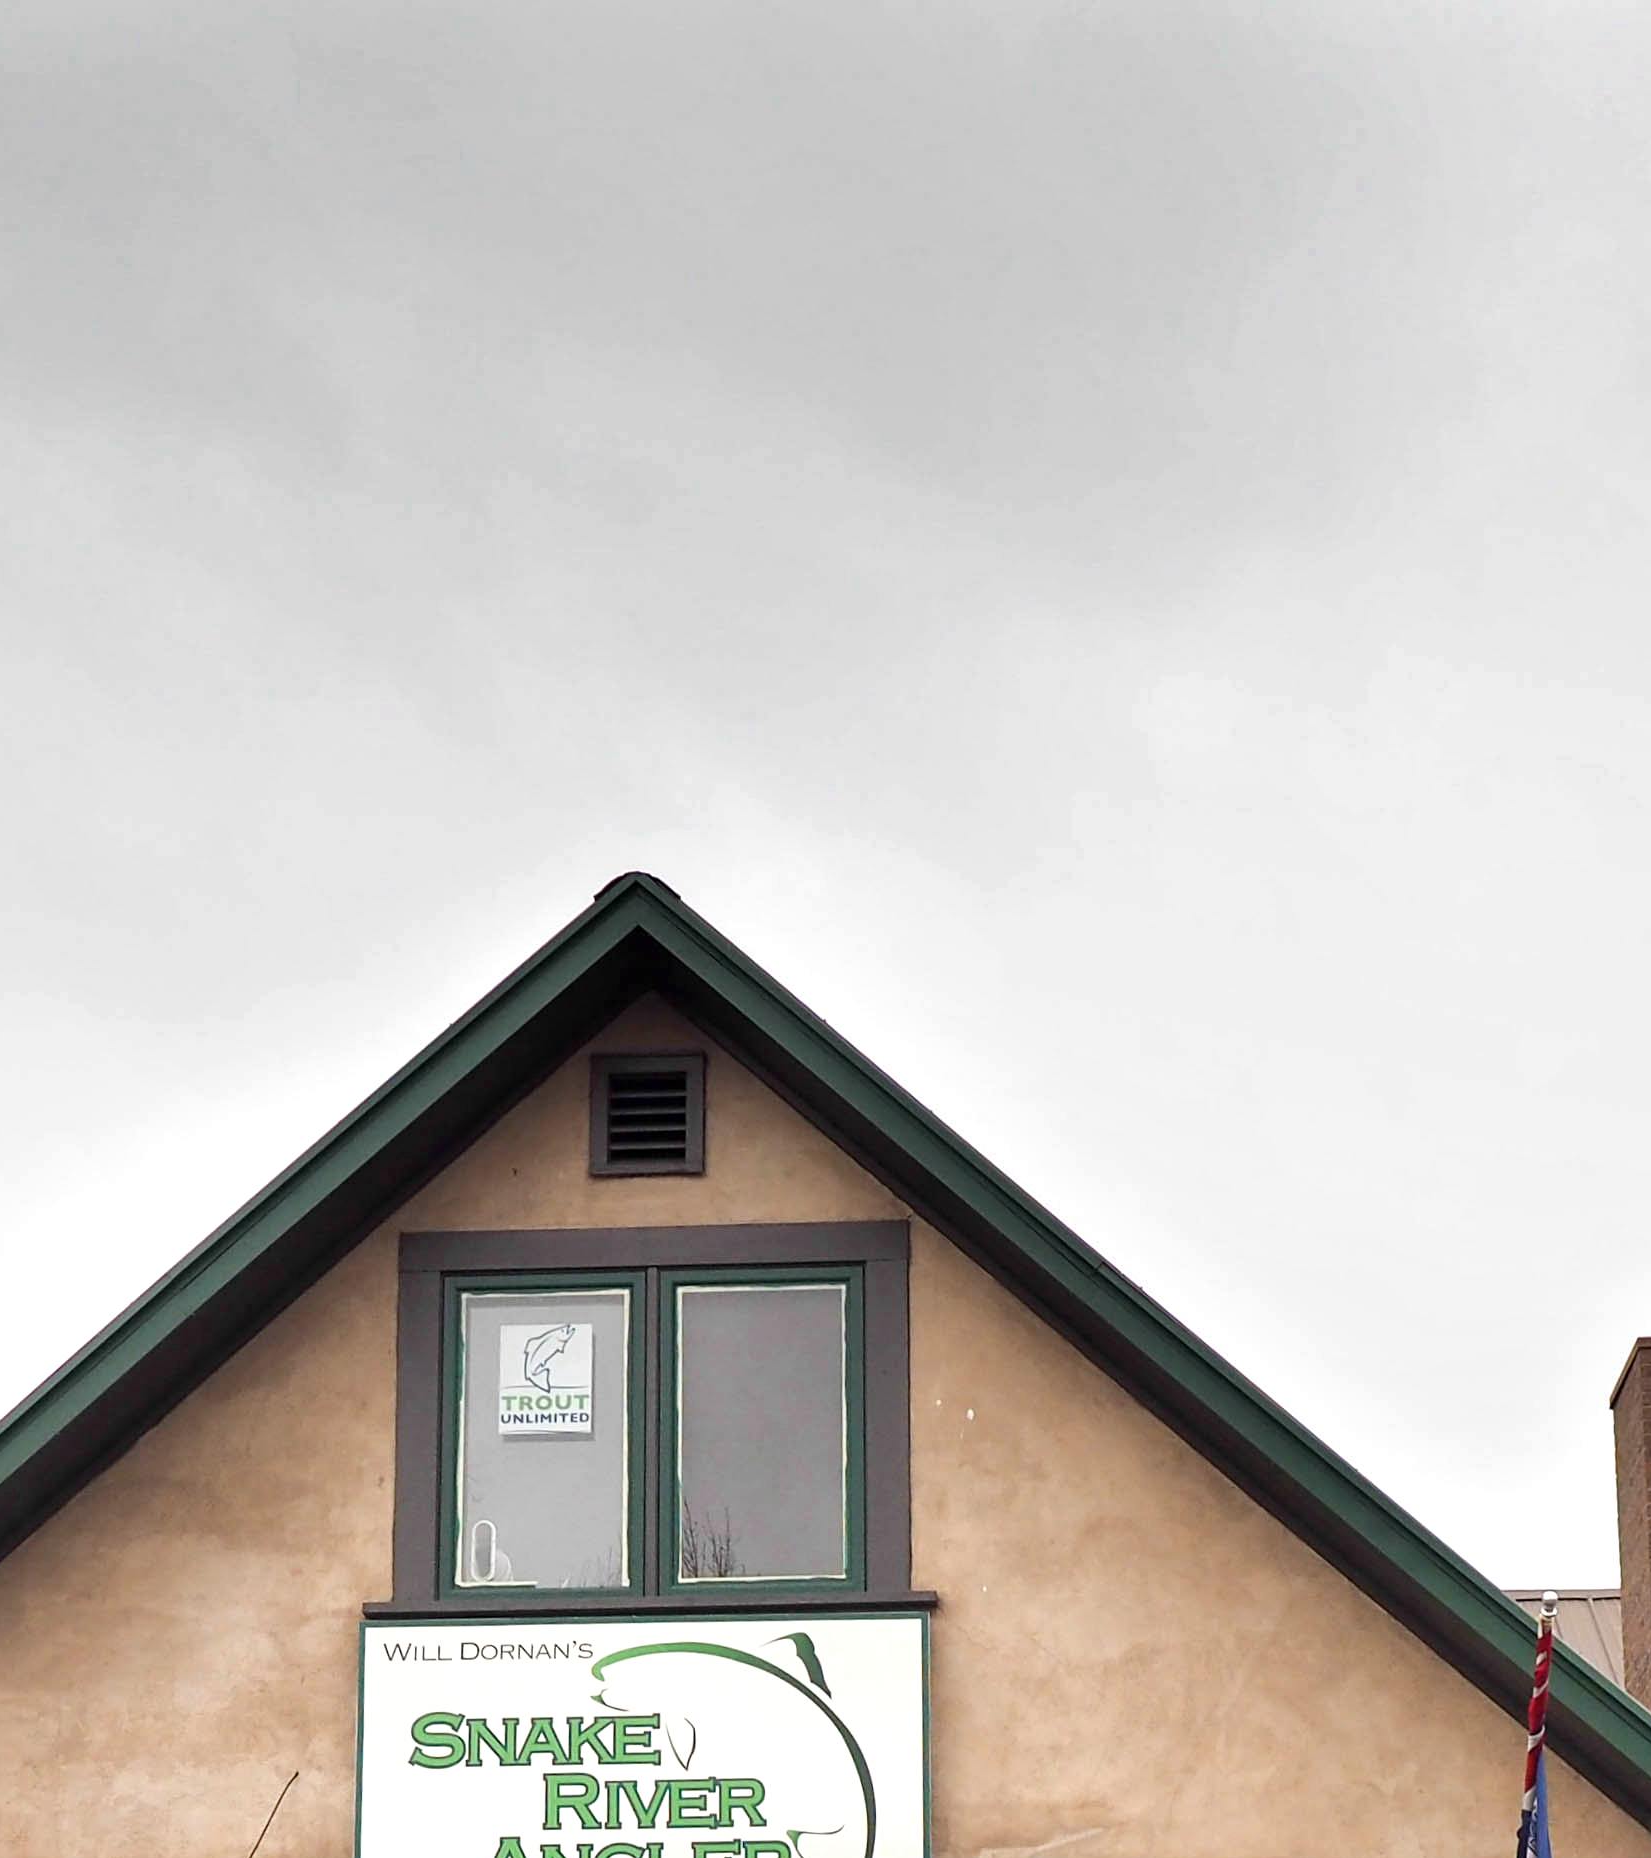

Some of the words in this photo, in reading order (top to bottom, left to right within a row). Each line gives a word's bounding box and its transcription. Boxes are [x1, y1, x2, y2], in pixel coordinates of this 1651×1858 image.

[501, 1395, 589, 1411] TROUT
[501, 1413, 589, 1424] UNLIMITED
[384, 1642, 452, 1661] WILL
[460, 1640, 594, 1661] DORNAN'S
[409, 1712, 661, 1768] SNAKE
[543, 1773, 766, 1829] RIVER
